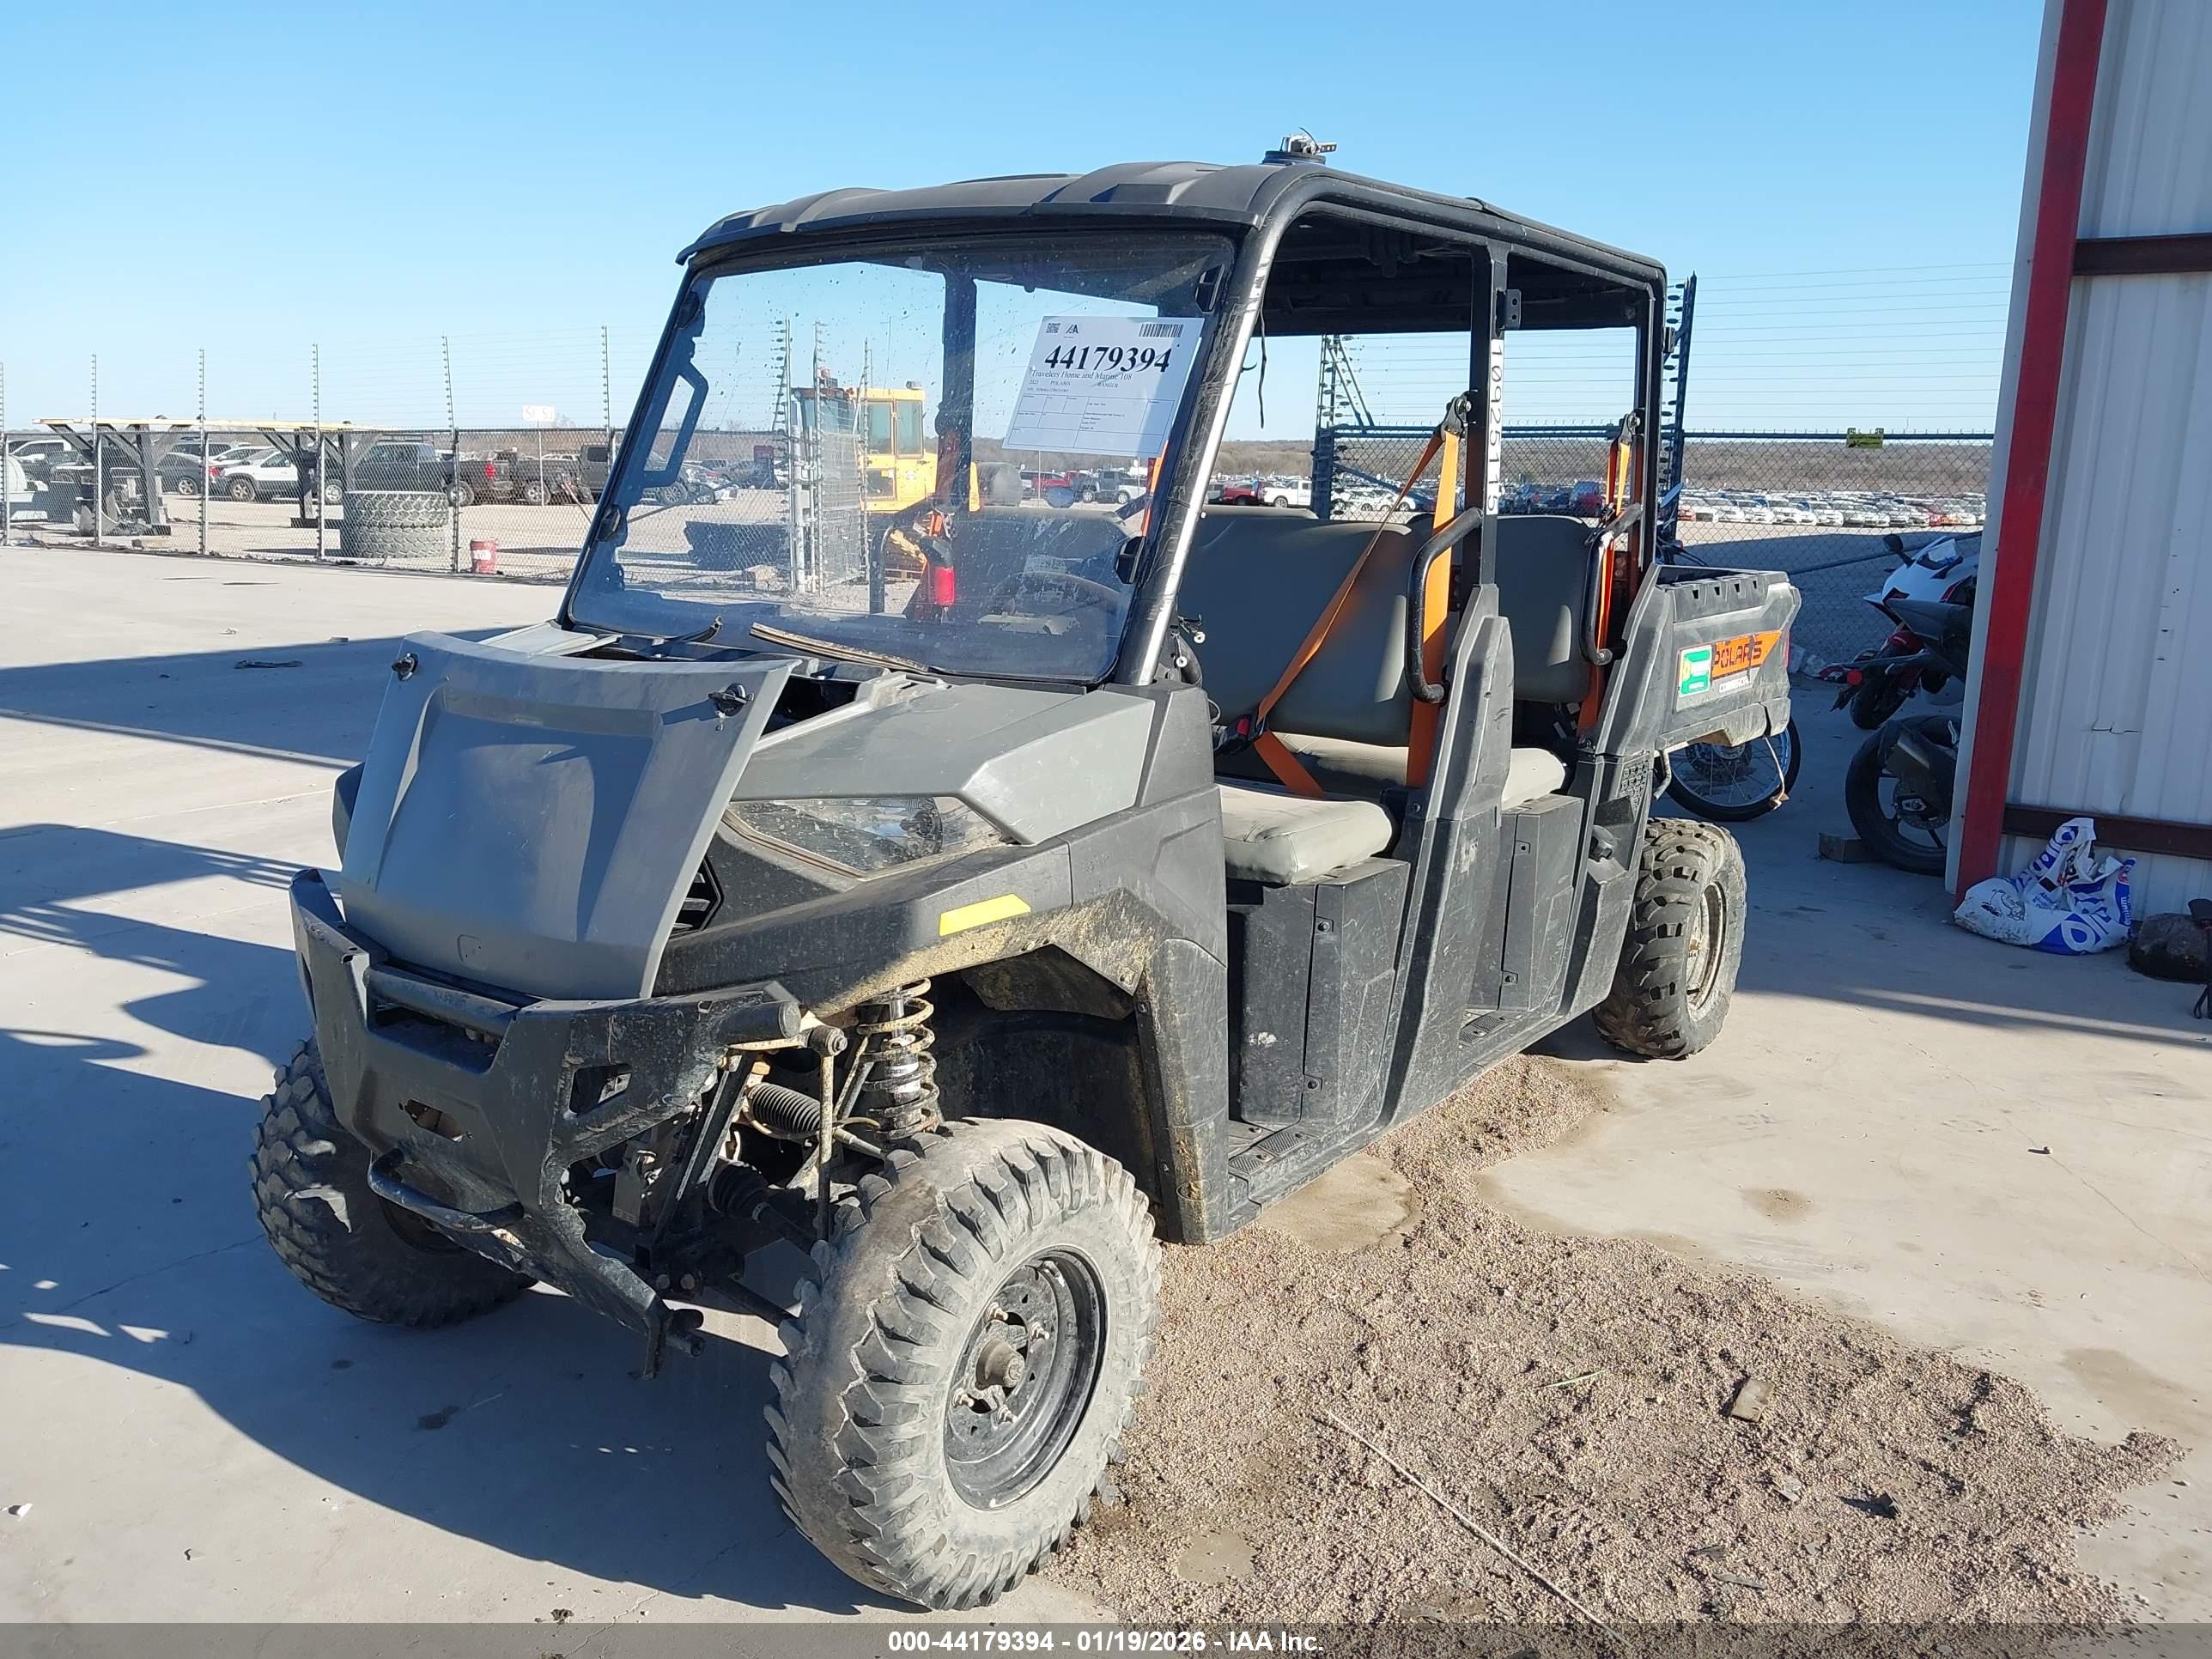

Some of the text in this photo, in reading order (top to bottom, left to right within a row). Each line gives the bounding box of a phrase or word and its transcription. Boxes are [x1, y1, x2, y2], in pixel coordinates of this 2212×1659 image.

[1044, 344, 1172, 373] 44179394
[1031, 369, 1060, 378] Travelers
[1082, 370, 1094, 380] and
[1095, 372, 1119, 380] Marine
[1486, 344, 1503, 511] 10925115
[1714, 641, 1763, 668] POLARS
